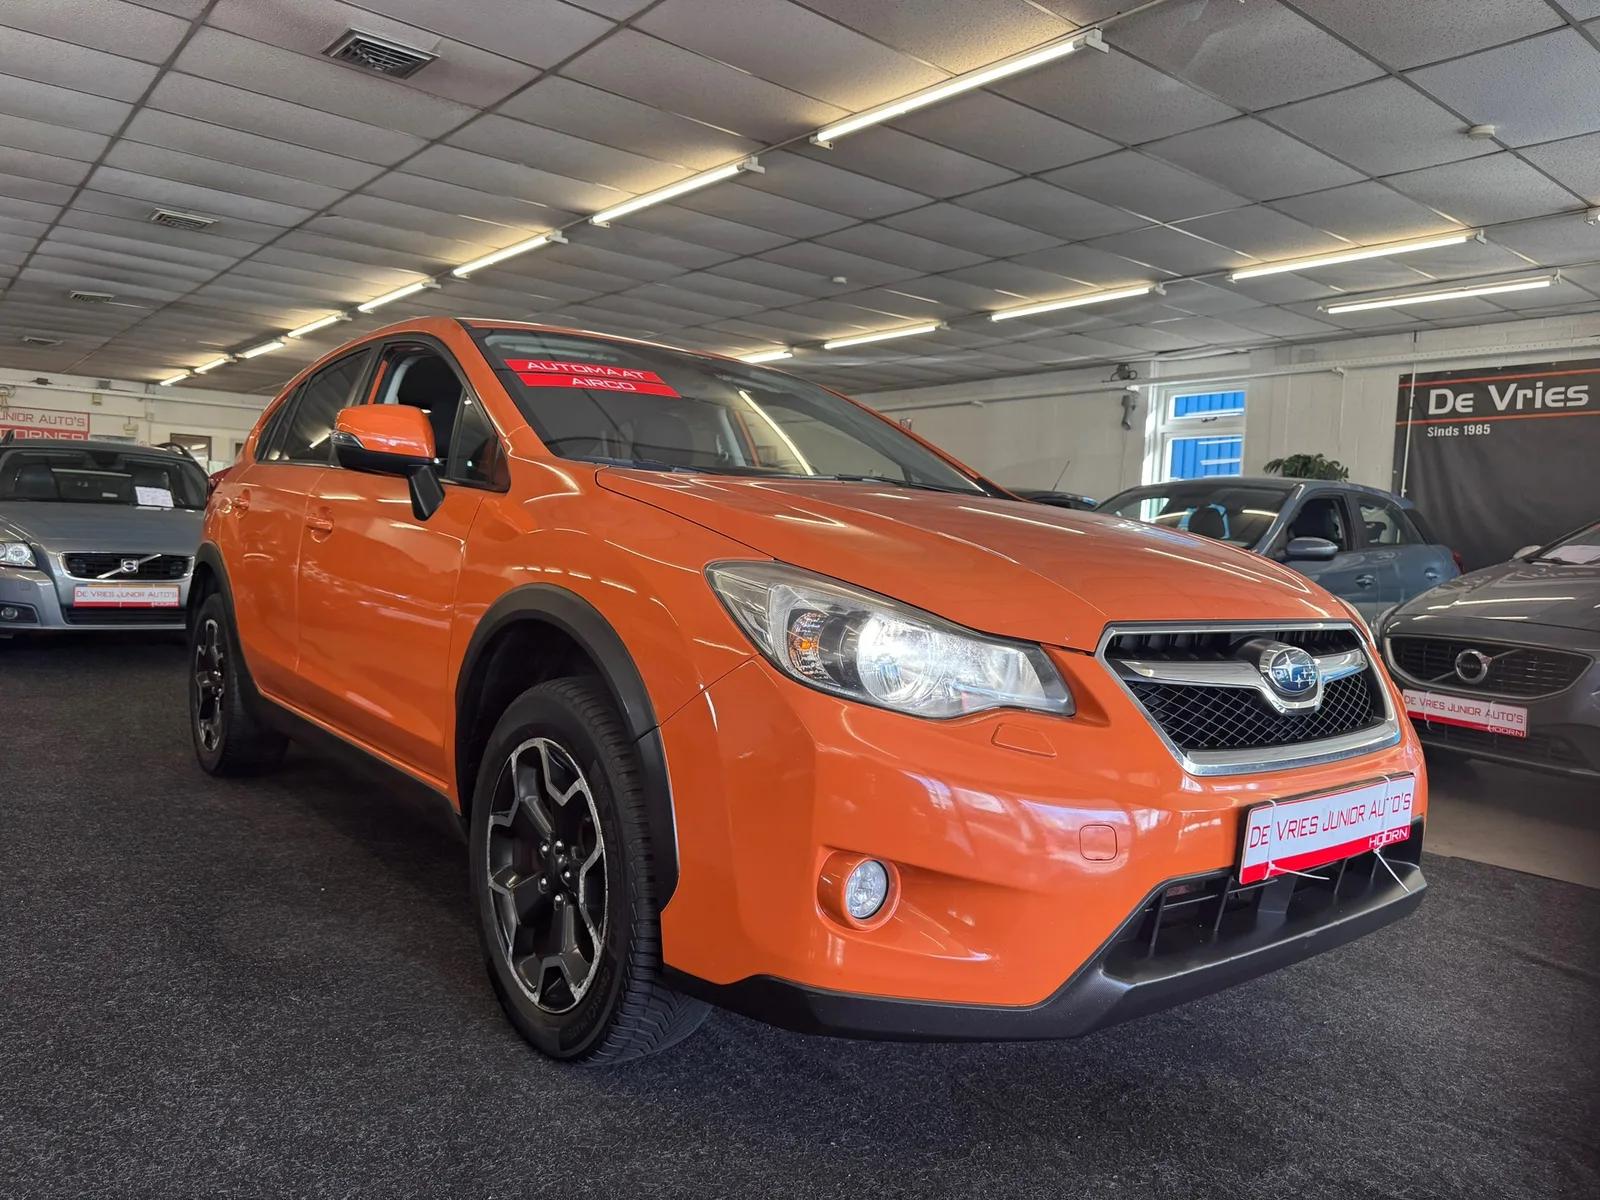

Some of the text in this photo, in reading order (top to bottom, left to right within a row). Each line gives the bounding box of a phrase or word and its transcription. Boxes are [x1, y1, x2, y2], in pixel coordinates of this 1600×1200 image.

[527, 361, 643, 379] AUTOMAAT
[572, 378, 636, 391] AIRCO
[1428, 381, 1589, 415] De Vries
[39, 414, 85, 427] AUTO'S
[1427, 424, 1490, 437] Sinds 1985
[1404, 695, 1524, 724] DE VRIES JUNIOR AUTO'S
[1249, 793, 1411, 848] DE VRIES JUNIOR AUO'S
[1368, 828, 1408, 848] HOORN
